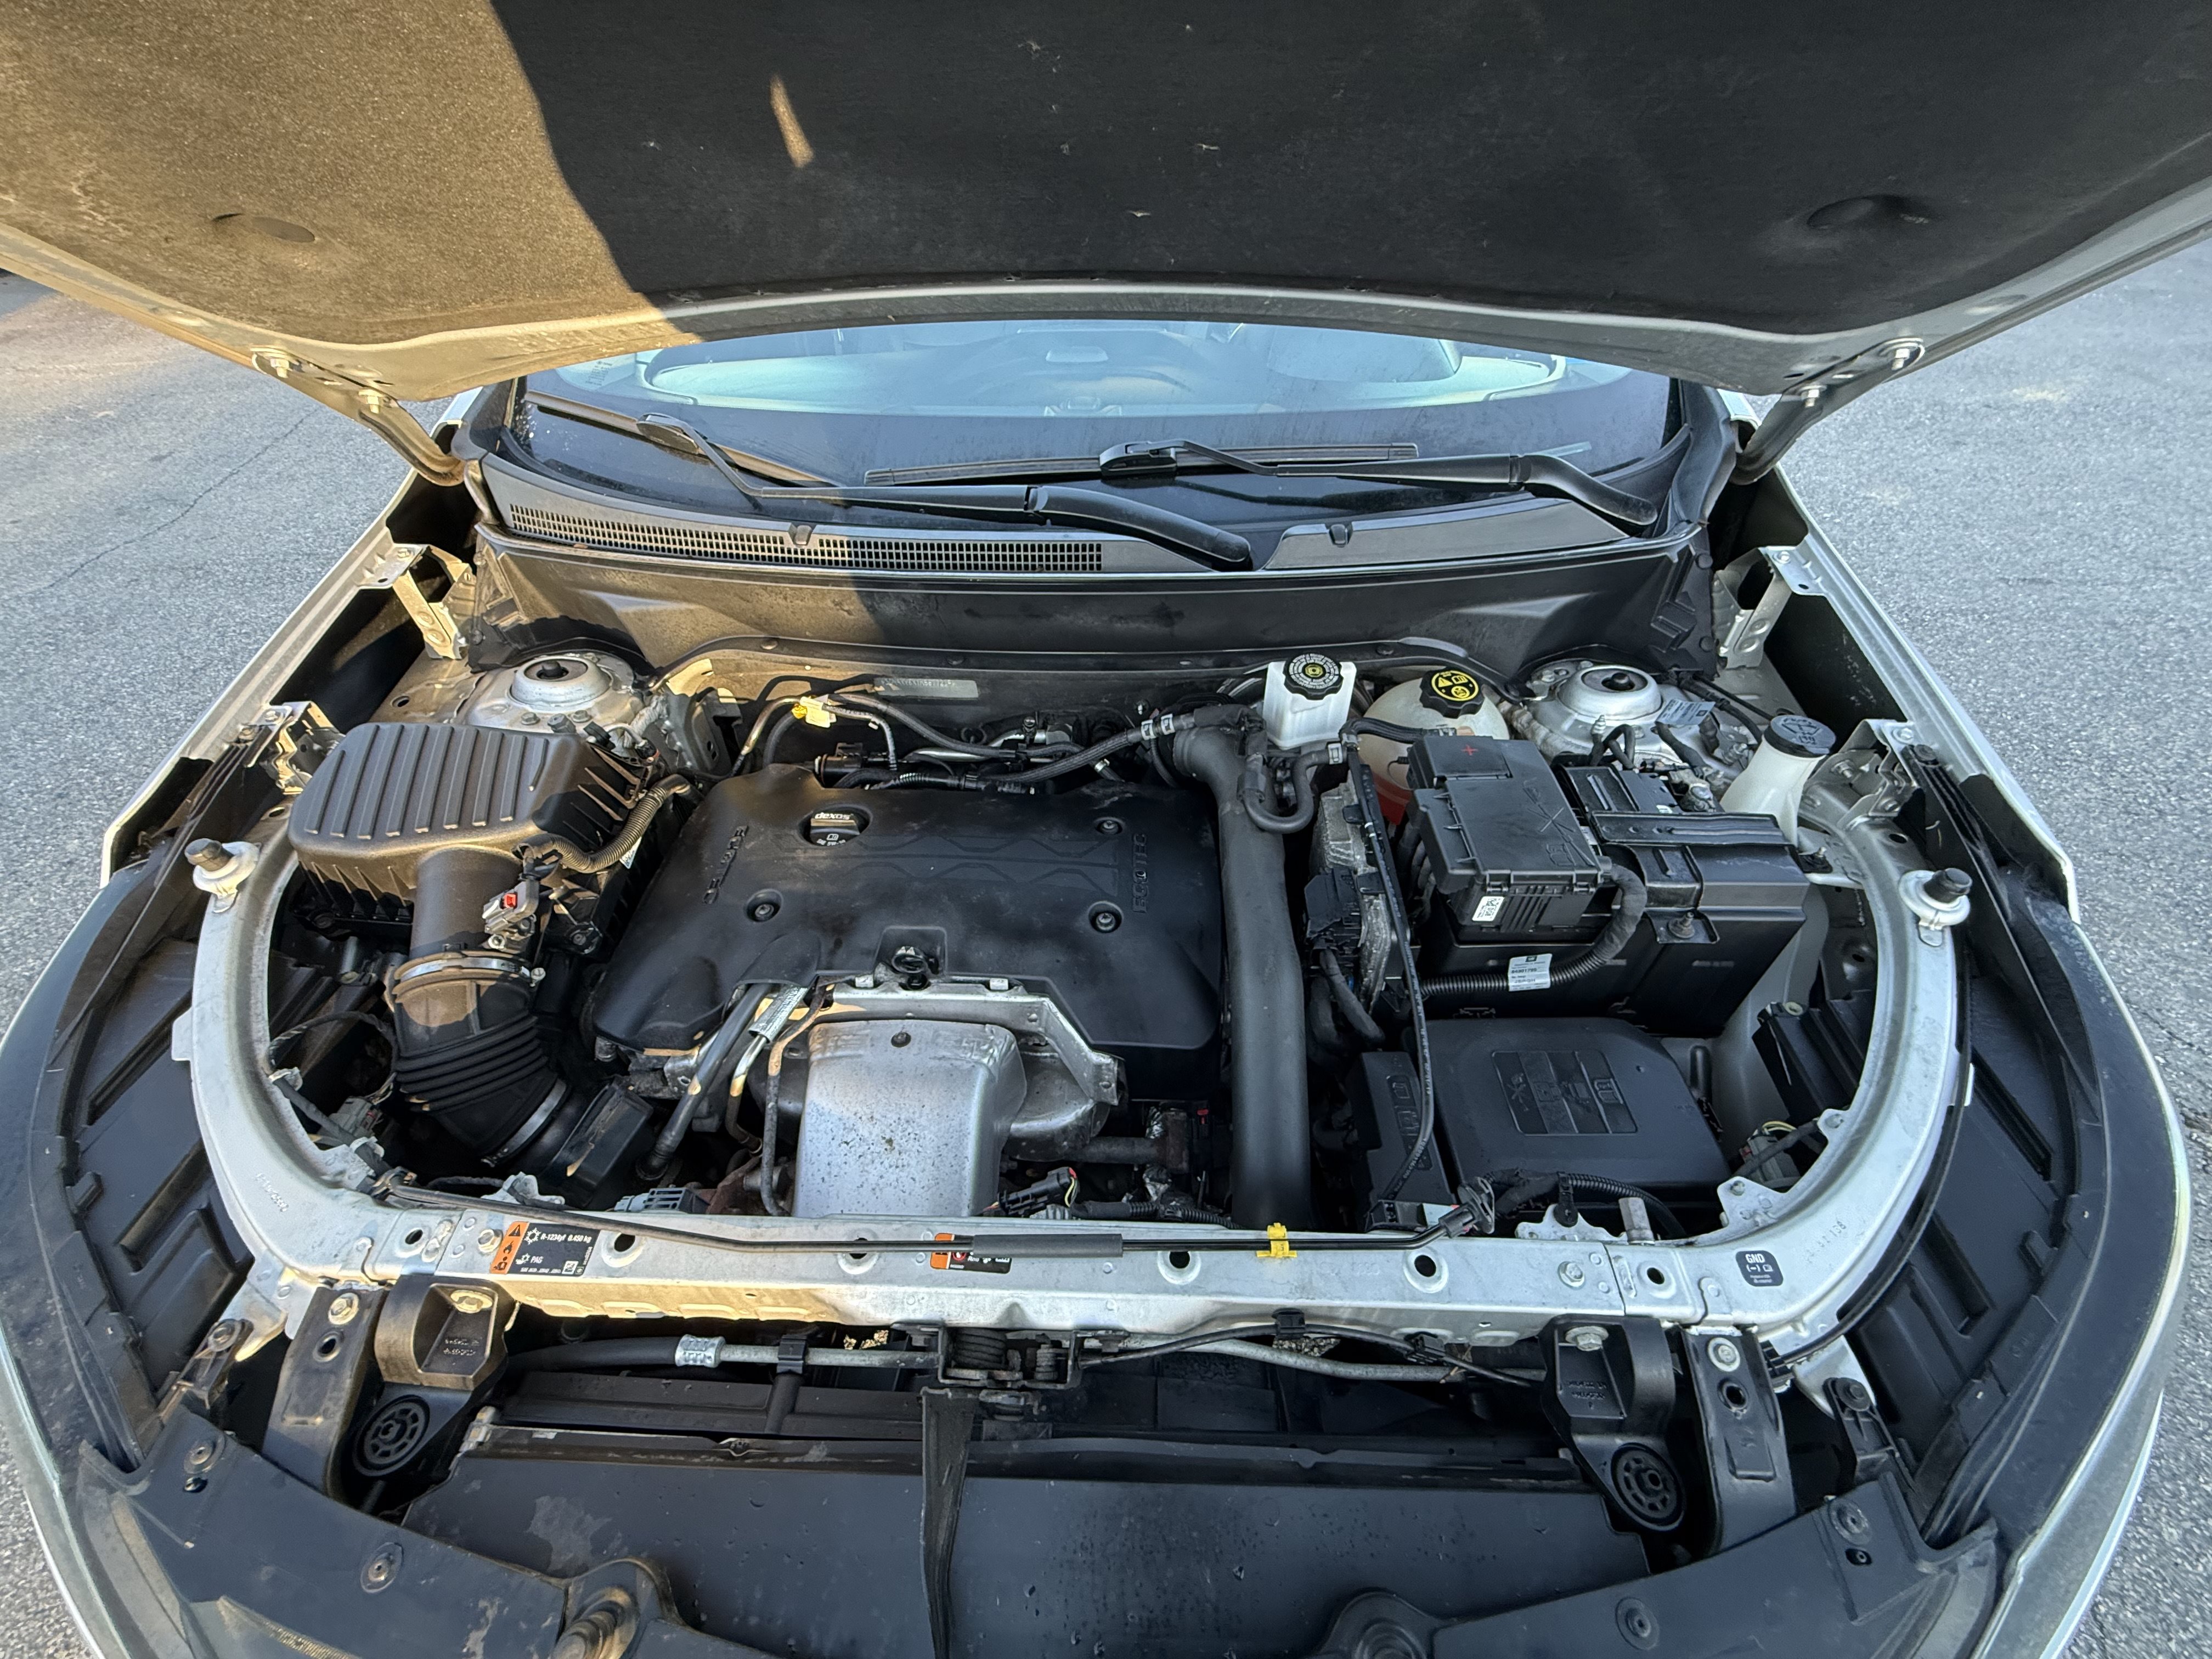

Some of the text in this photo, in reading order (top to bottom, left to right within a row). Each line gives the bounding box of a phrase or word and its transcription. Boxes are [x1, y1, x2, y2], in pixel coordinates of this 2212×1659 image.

[1131, 833, 1149, 913] ECOTEC
[540, 1233, 566, 1242] R-1234yf
[1745, 1253, 1765, 1264] GND
